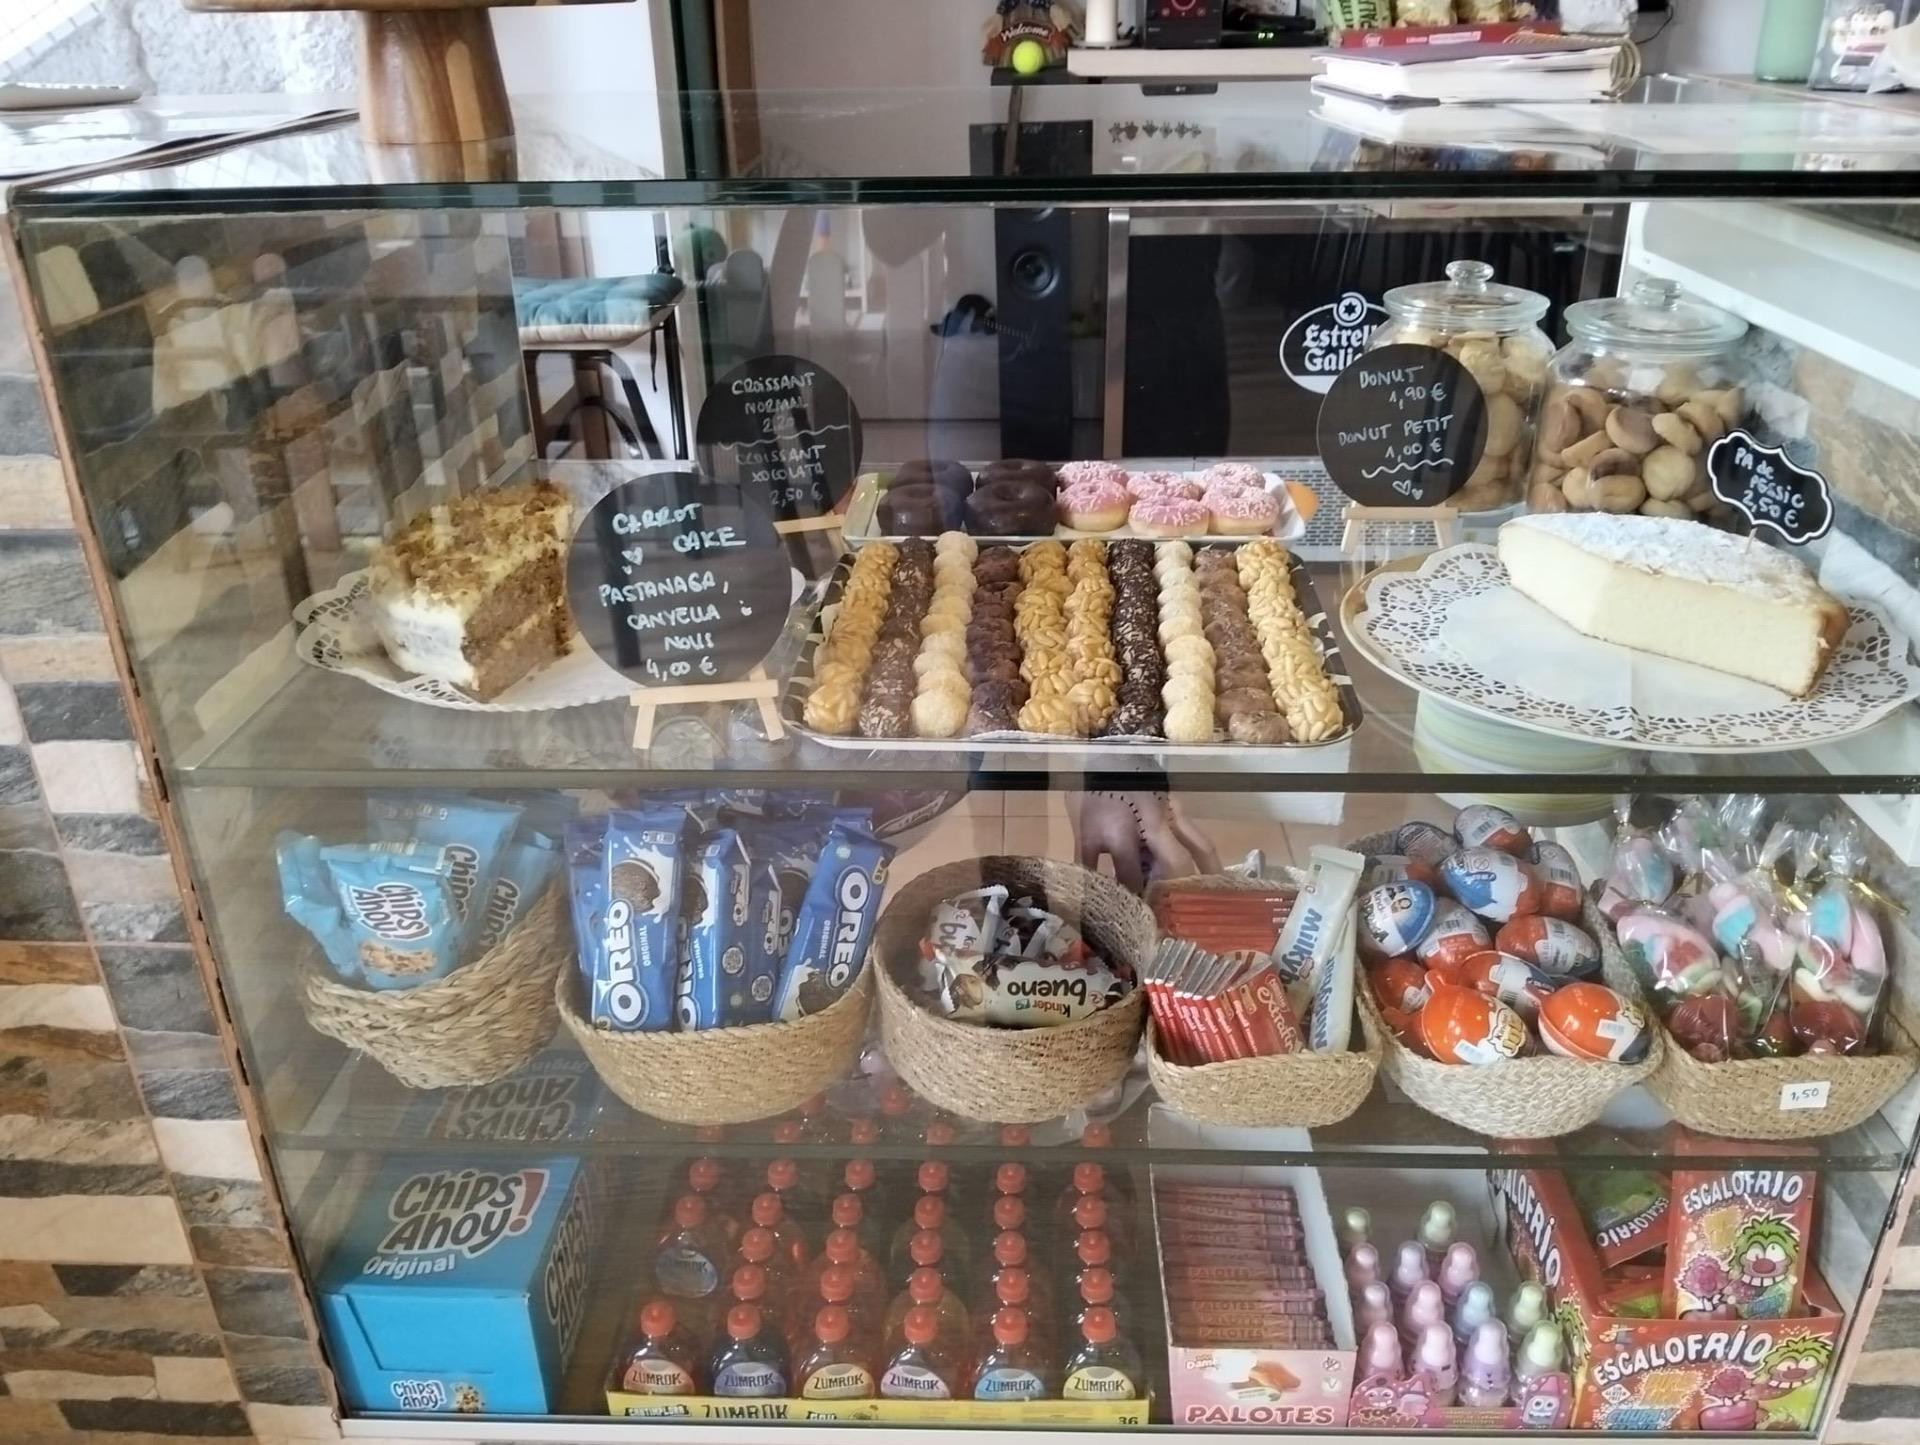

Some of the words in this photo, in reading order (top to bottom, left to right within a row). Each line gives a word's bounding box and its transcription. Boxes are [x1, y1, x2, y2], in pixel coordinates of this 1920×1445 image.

[1001, 23, 1048, 41] Welcome
[1302, 324, 1377, 347] Estrel
[1304, 348, 1362, 371] Gali
[1360, 366, 1424, 389] DONUT
[1389, 386, 1427, 410] 1,90
[1431, 382, 1446, 401] €
[1338, 424, 1392, 447] DONUT
[1385, 443, 1422, 463] 1,00
[1430, 437, 1442, 452] €
[612, 503, 703, 535] CARROT
[1742, 490, 1781, 517] 2,50
[1784, 509, 1798, 528] €
[673, 526, 747, 553] CAKE
[627, 603, 721, 630] CANYELLA
[664, 633, 714, 651] NOUS
[646, 658, 691, 682] 4,00
[700, 656, 717, 676] €
[377, 884, 425, 931] Chips
[480, 879, 519, 944] Chips
[818, 920, 831, 960] ORIGINAL
[830, 872, 869, 987] OREO
[639, 925, 652, 967] ORIGINAL
[1280, 907, 1322, 984] Milkyb
[609, 901, 643, 1023] OREO
[1007, 978, 1087, 1005] bueno
[1256, 986, 1295, 1052] extrafin
[1791, 1087, 1819, 1101] 1,50
[393, 1171, 523, 1219] Chips
[364, 1254, 456, 1280] Original
[393, 1382, 434, 1397] Chips
[632, 1370, 683, 1386] ZUMROK
[724, 1372, 775, 1387] ZUMROK
[814, 1374, 864, 1390] ZUMROK
[890, 1373, 940, 1390] ZUMROK
[985, 1379, 1036, 1392] ZUMROK
[1074, 1376, 1125, 1392] ZUMROK
[702, 1404, 789, 1419] ZUMROK
[1187, 1406, 1334, 1424] PALOTES
